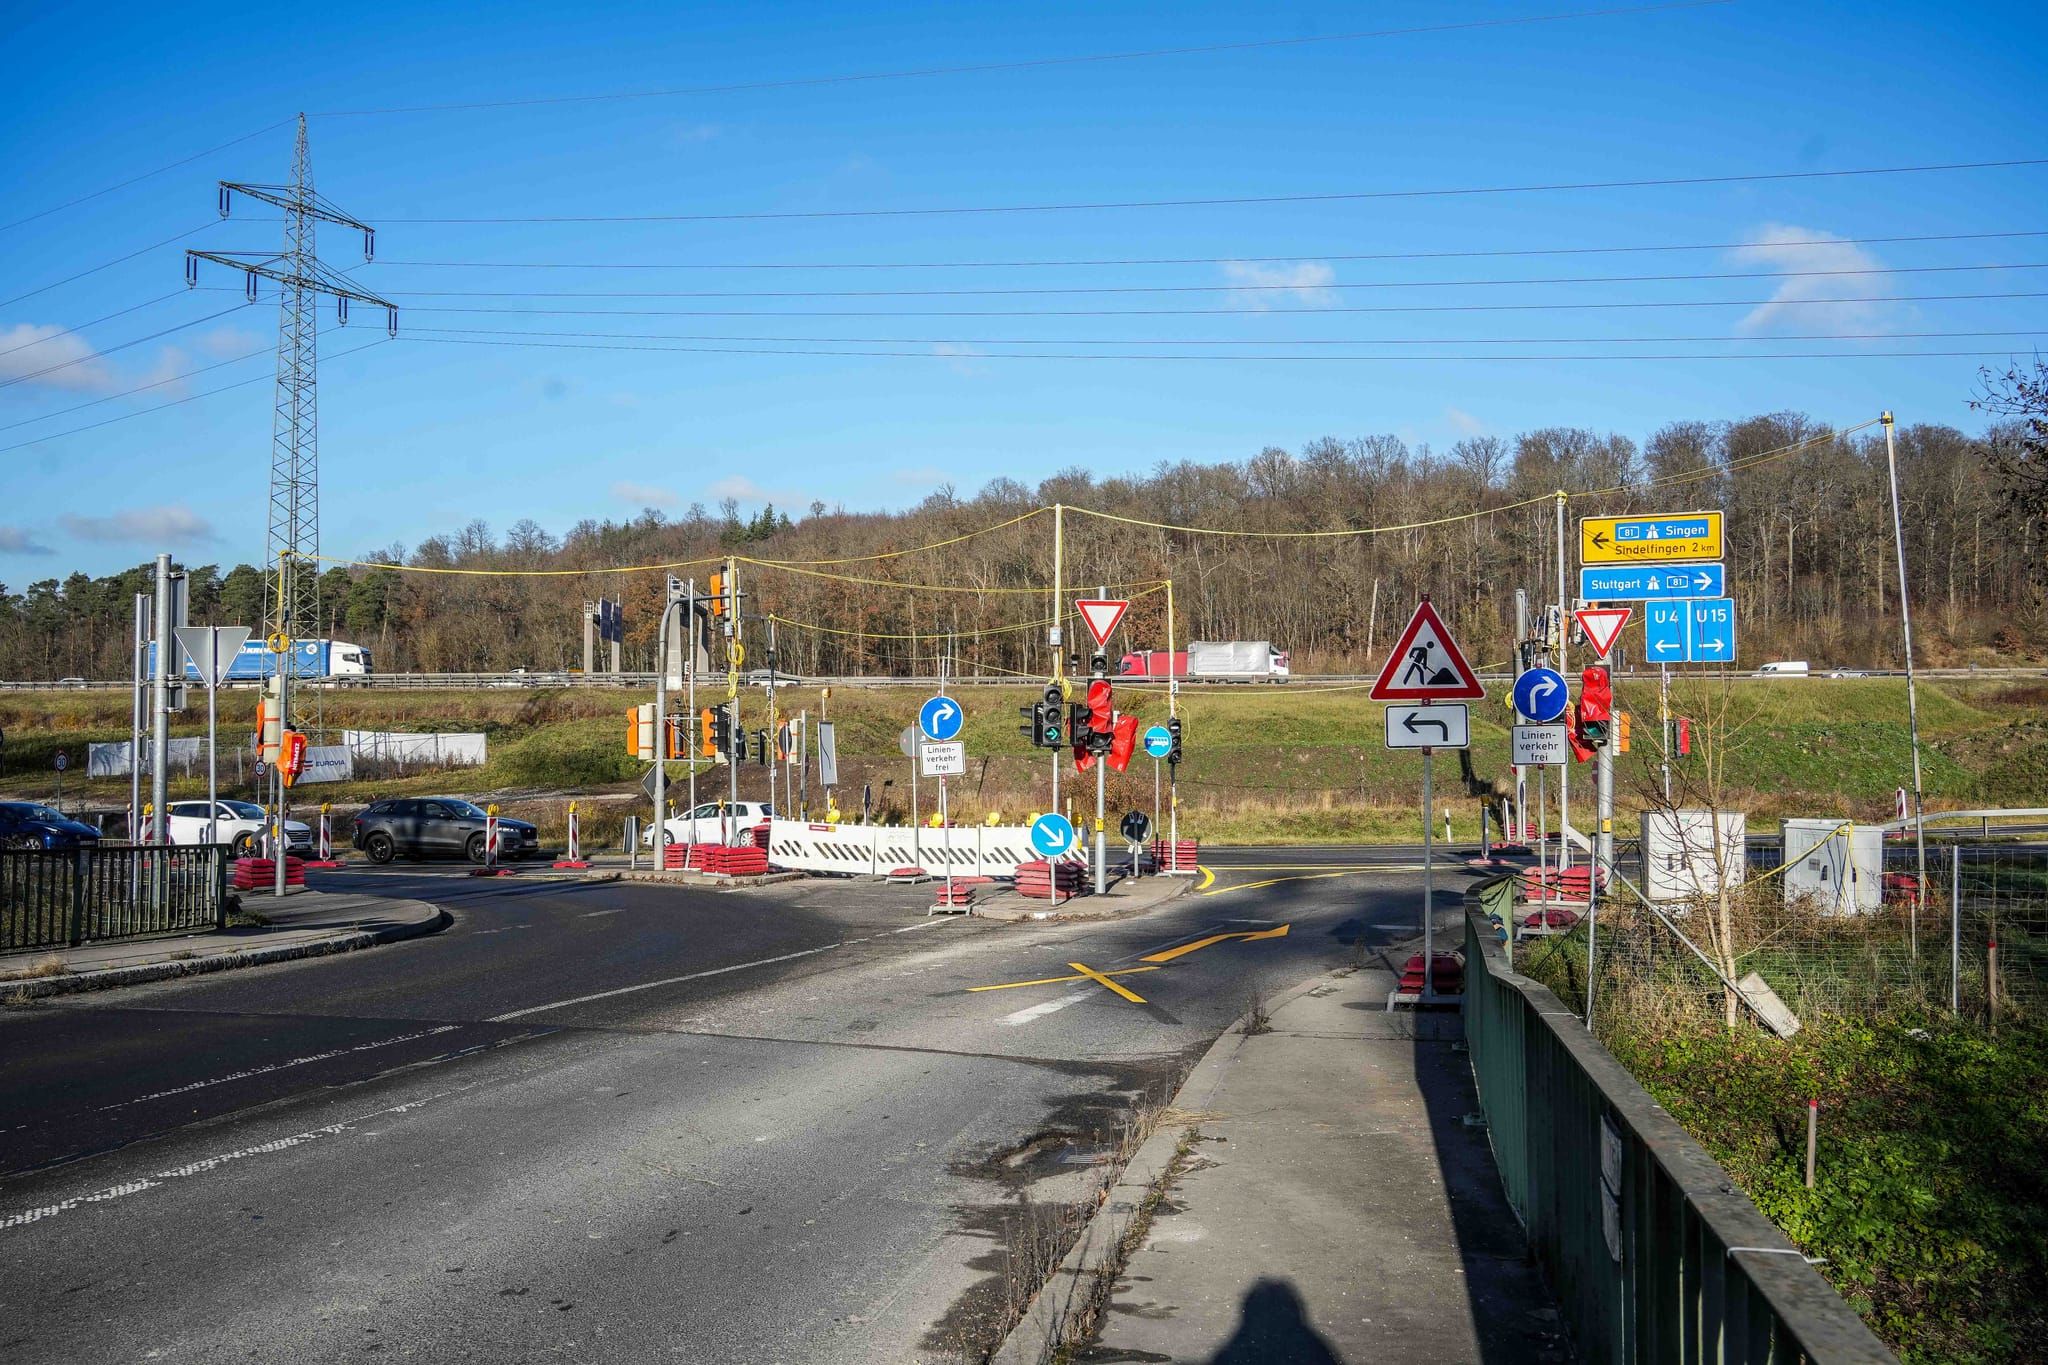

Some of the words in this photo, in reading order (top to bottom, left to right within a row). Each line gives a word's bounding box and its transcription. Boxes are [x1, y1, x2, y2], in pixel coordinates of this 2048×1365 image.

[1624, 529, 1634, 537] 81
[1665, 526, 1705, 537] Singen
[1615, 544, 1686, 556] Sindelfingen
[1692, 543, 1698, 552] 2
[1591, 579, 1641, 590] Stuttgart
[1673, 578, 1682, 586] 81
[1655, 610, 1666, 624] U
[1669, 610, 1679, 623] 4
[1696, 609, 1708, 623] U
[1711, 609, 1727, 622] 15
[1521, 731, 1556, 739] Linien-
[928, 746, 955, 754] Linien-
[1519, 742, 1559, 750] verkehr
[927, 755, 957, 763] verkehr
[1531, 753, 1548, 761] frei
[256, 763, 265, 773] 30
[315, 760, 345, 768] EUROVIA
